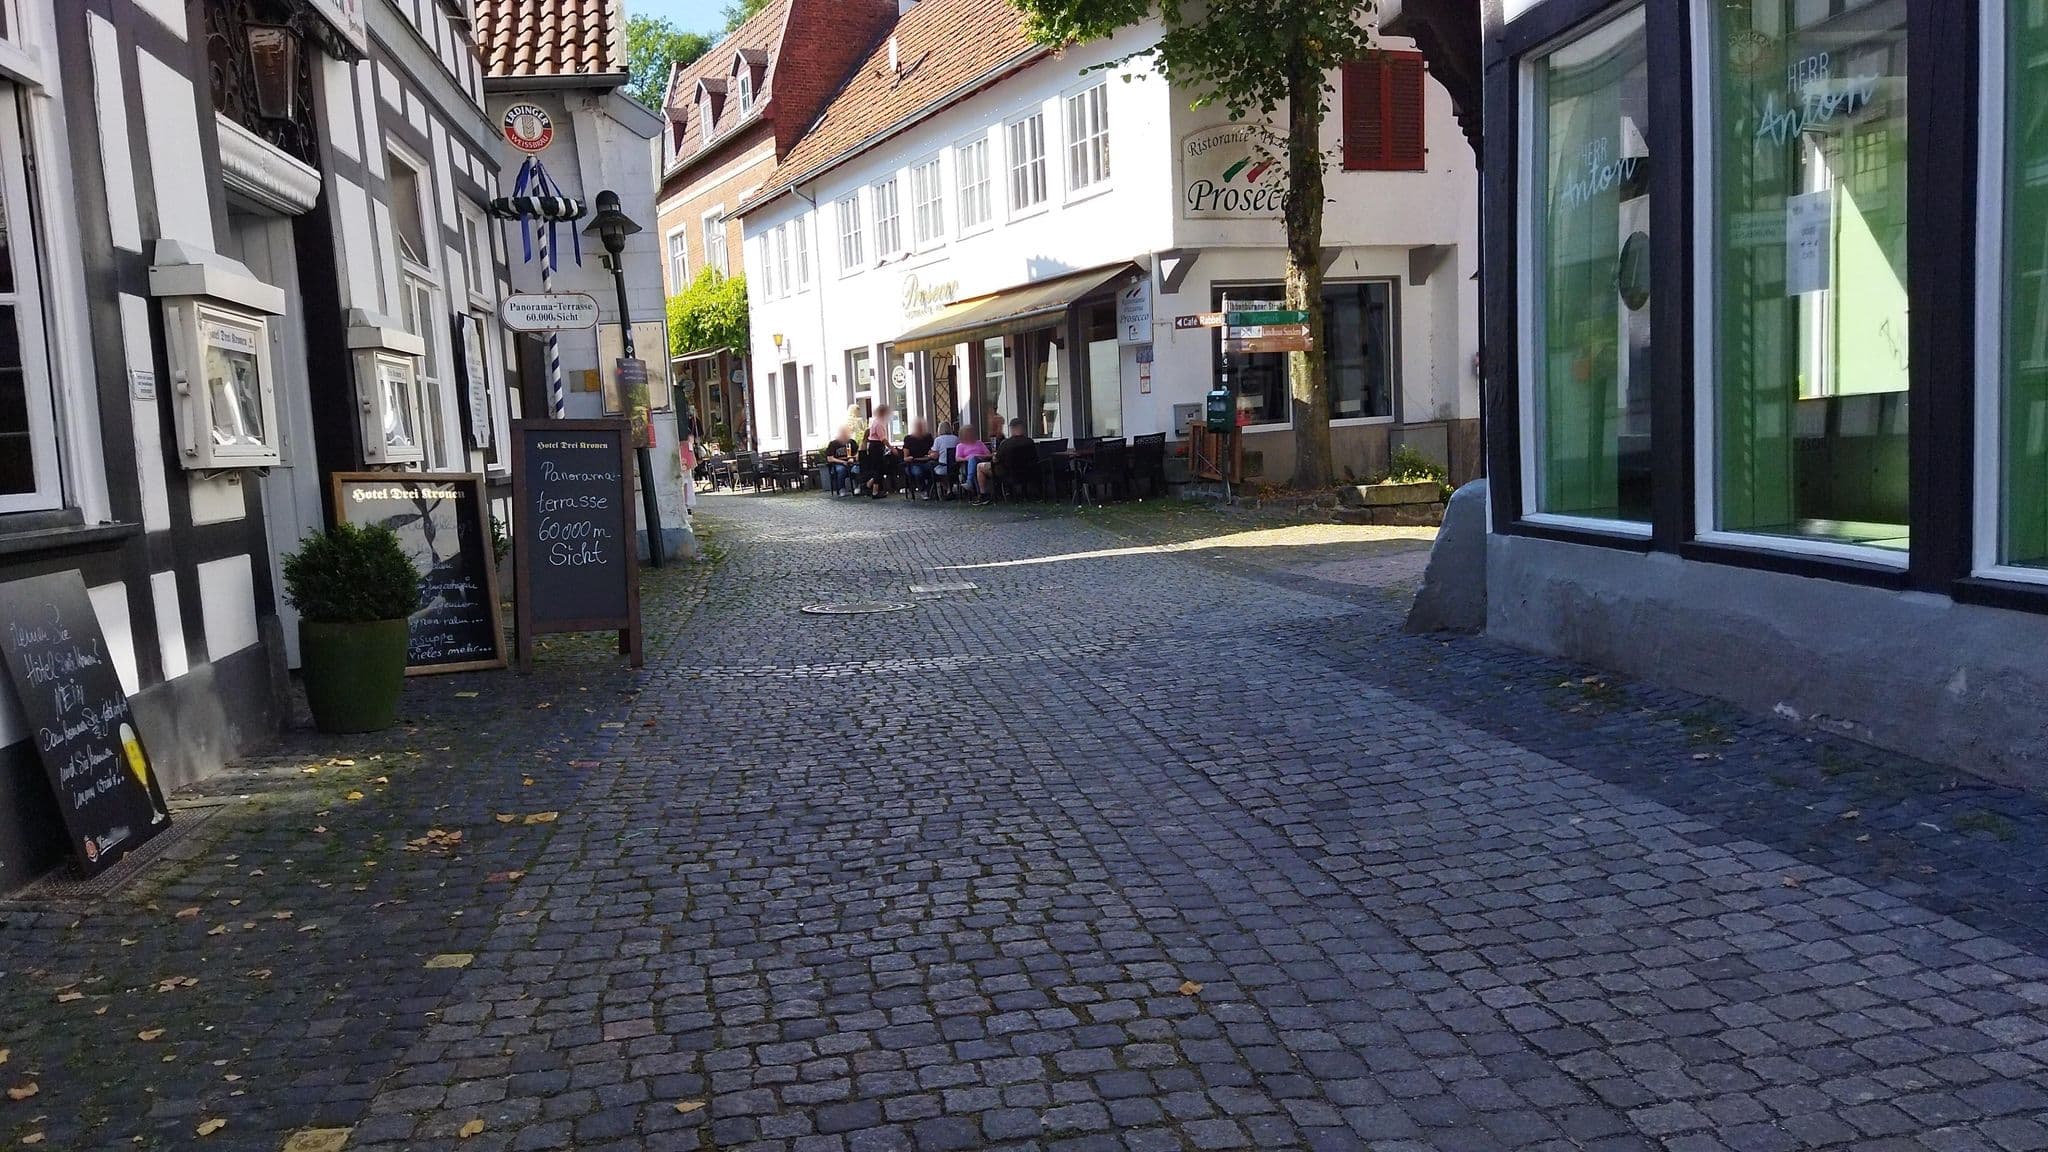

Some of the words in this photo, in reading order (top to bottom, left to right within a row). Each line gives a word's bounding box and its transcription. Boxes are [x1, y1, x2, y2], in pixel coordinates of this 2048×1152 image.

[1787, 52, 1829, 93] HERR
[505, 106, 549, 126] ERDINGER
[1755, 73, 1879, 155] Anton
[1188, 131, 1250, 156] Ristorante
[1187, 179, 1291, 211] Prosecc
[1561, 157, 1637, 210] Anton
[510, 301, 593, 312] Panorama-Terrasse
[536, 441, 559, 450] Hotel
[560, 441, 578, 449] Drei
[352, 488, 388, 502] Hotel
[390, 488, 419, 500] Drei
[421, 488, 466, 500] Kronen
[536, 491, 608, 514] terrasse
[549, 540, 607, 566] Sicht
